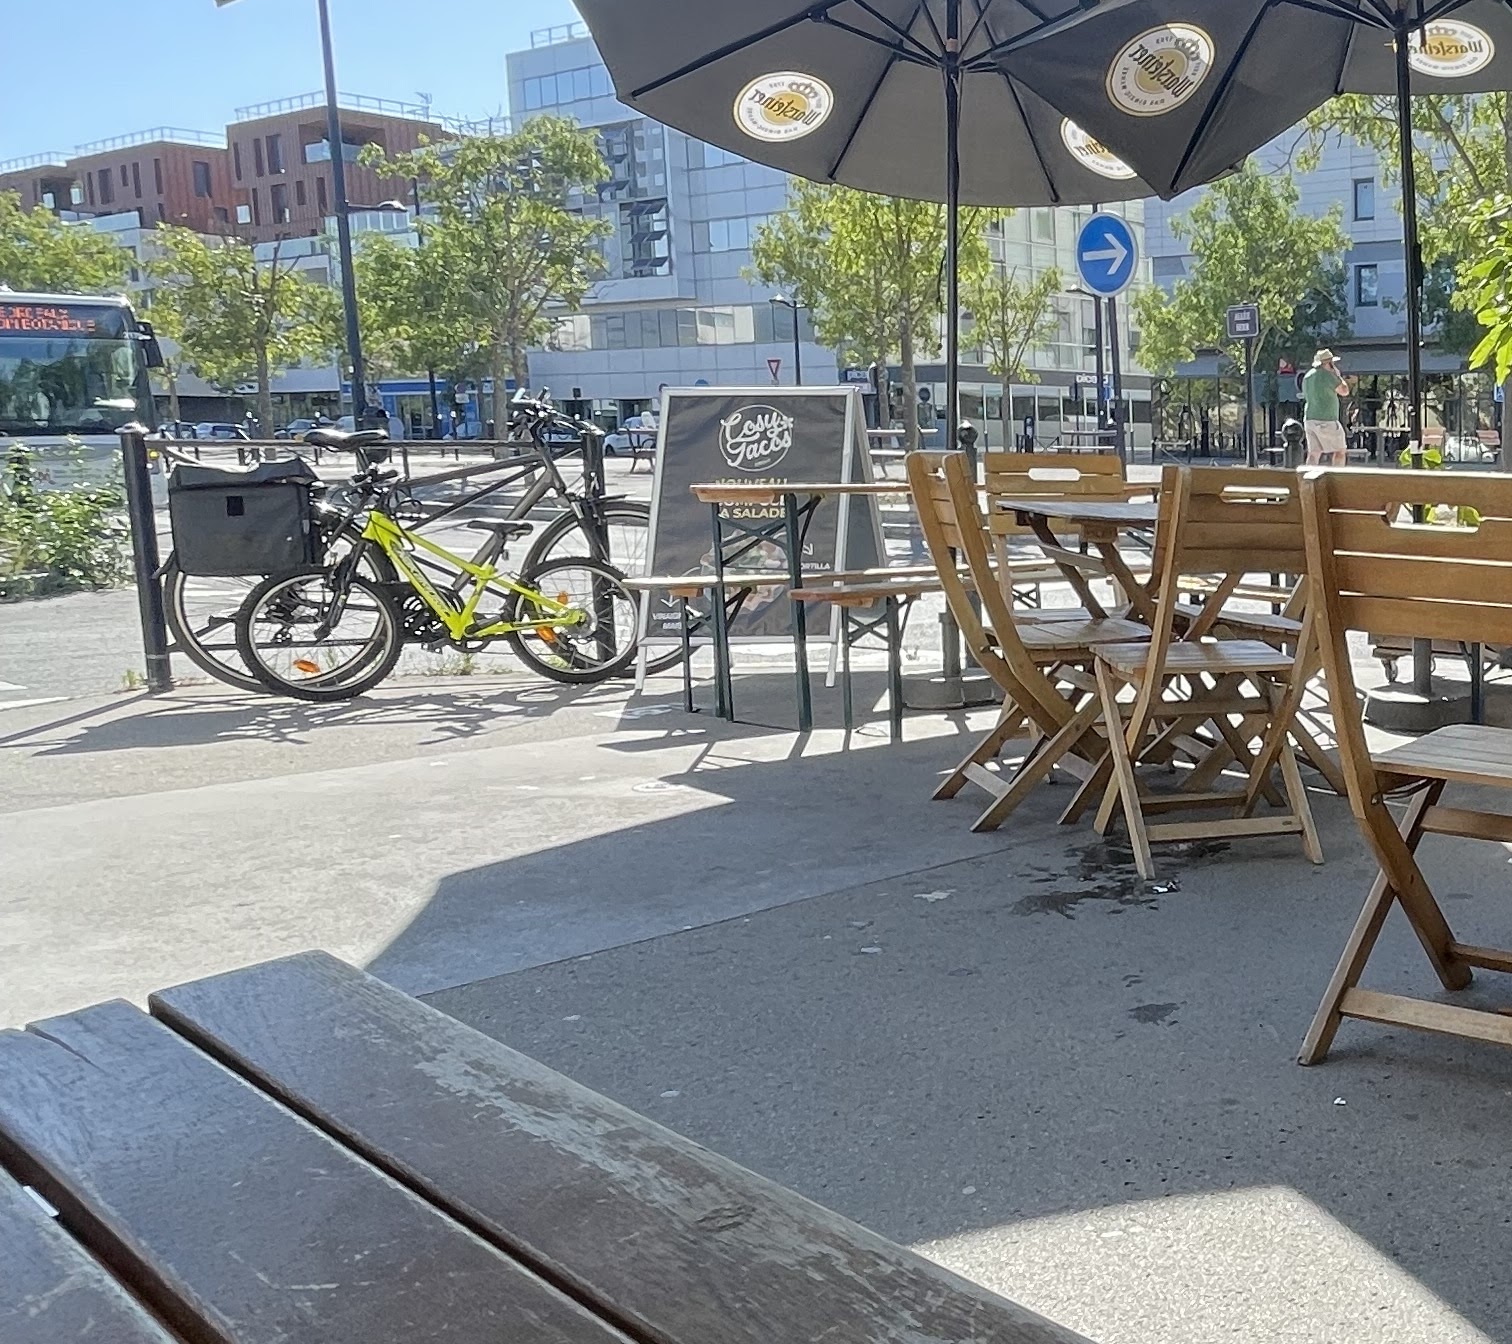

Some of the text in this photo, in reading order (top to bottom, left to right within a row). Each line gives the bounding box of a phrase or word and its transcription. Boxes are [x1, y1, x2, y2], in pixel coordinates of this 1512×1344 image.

[1076, 373, 1109, 384] picad
[720, 411, 783, 444] Cosy
[726, 430, 792, 467] Tacos
[732, 507, 786, 519] SALADE
[800, 562, 831, 571] ORTILLA
